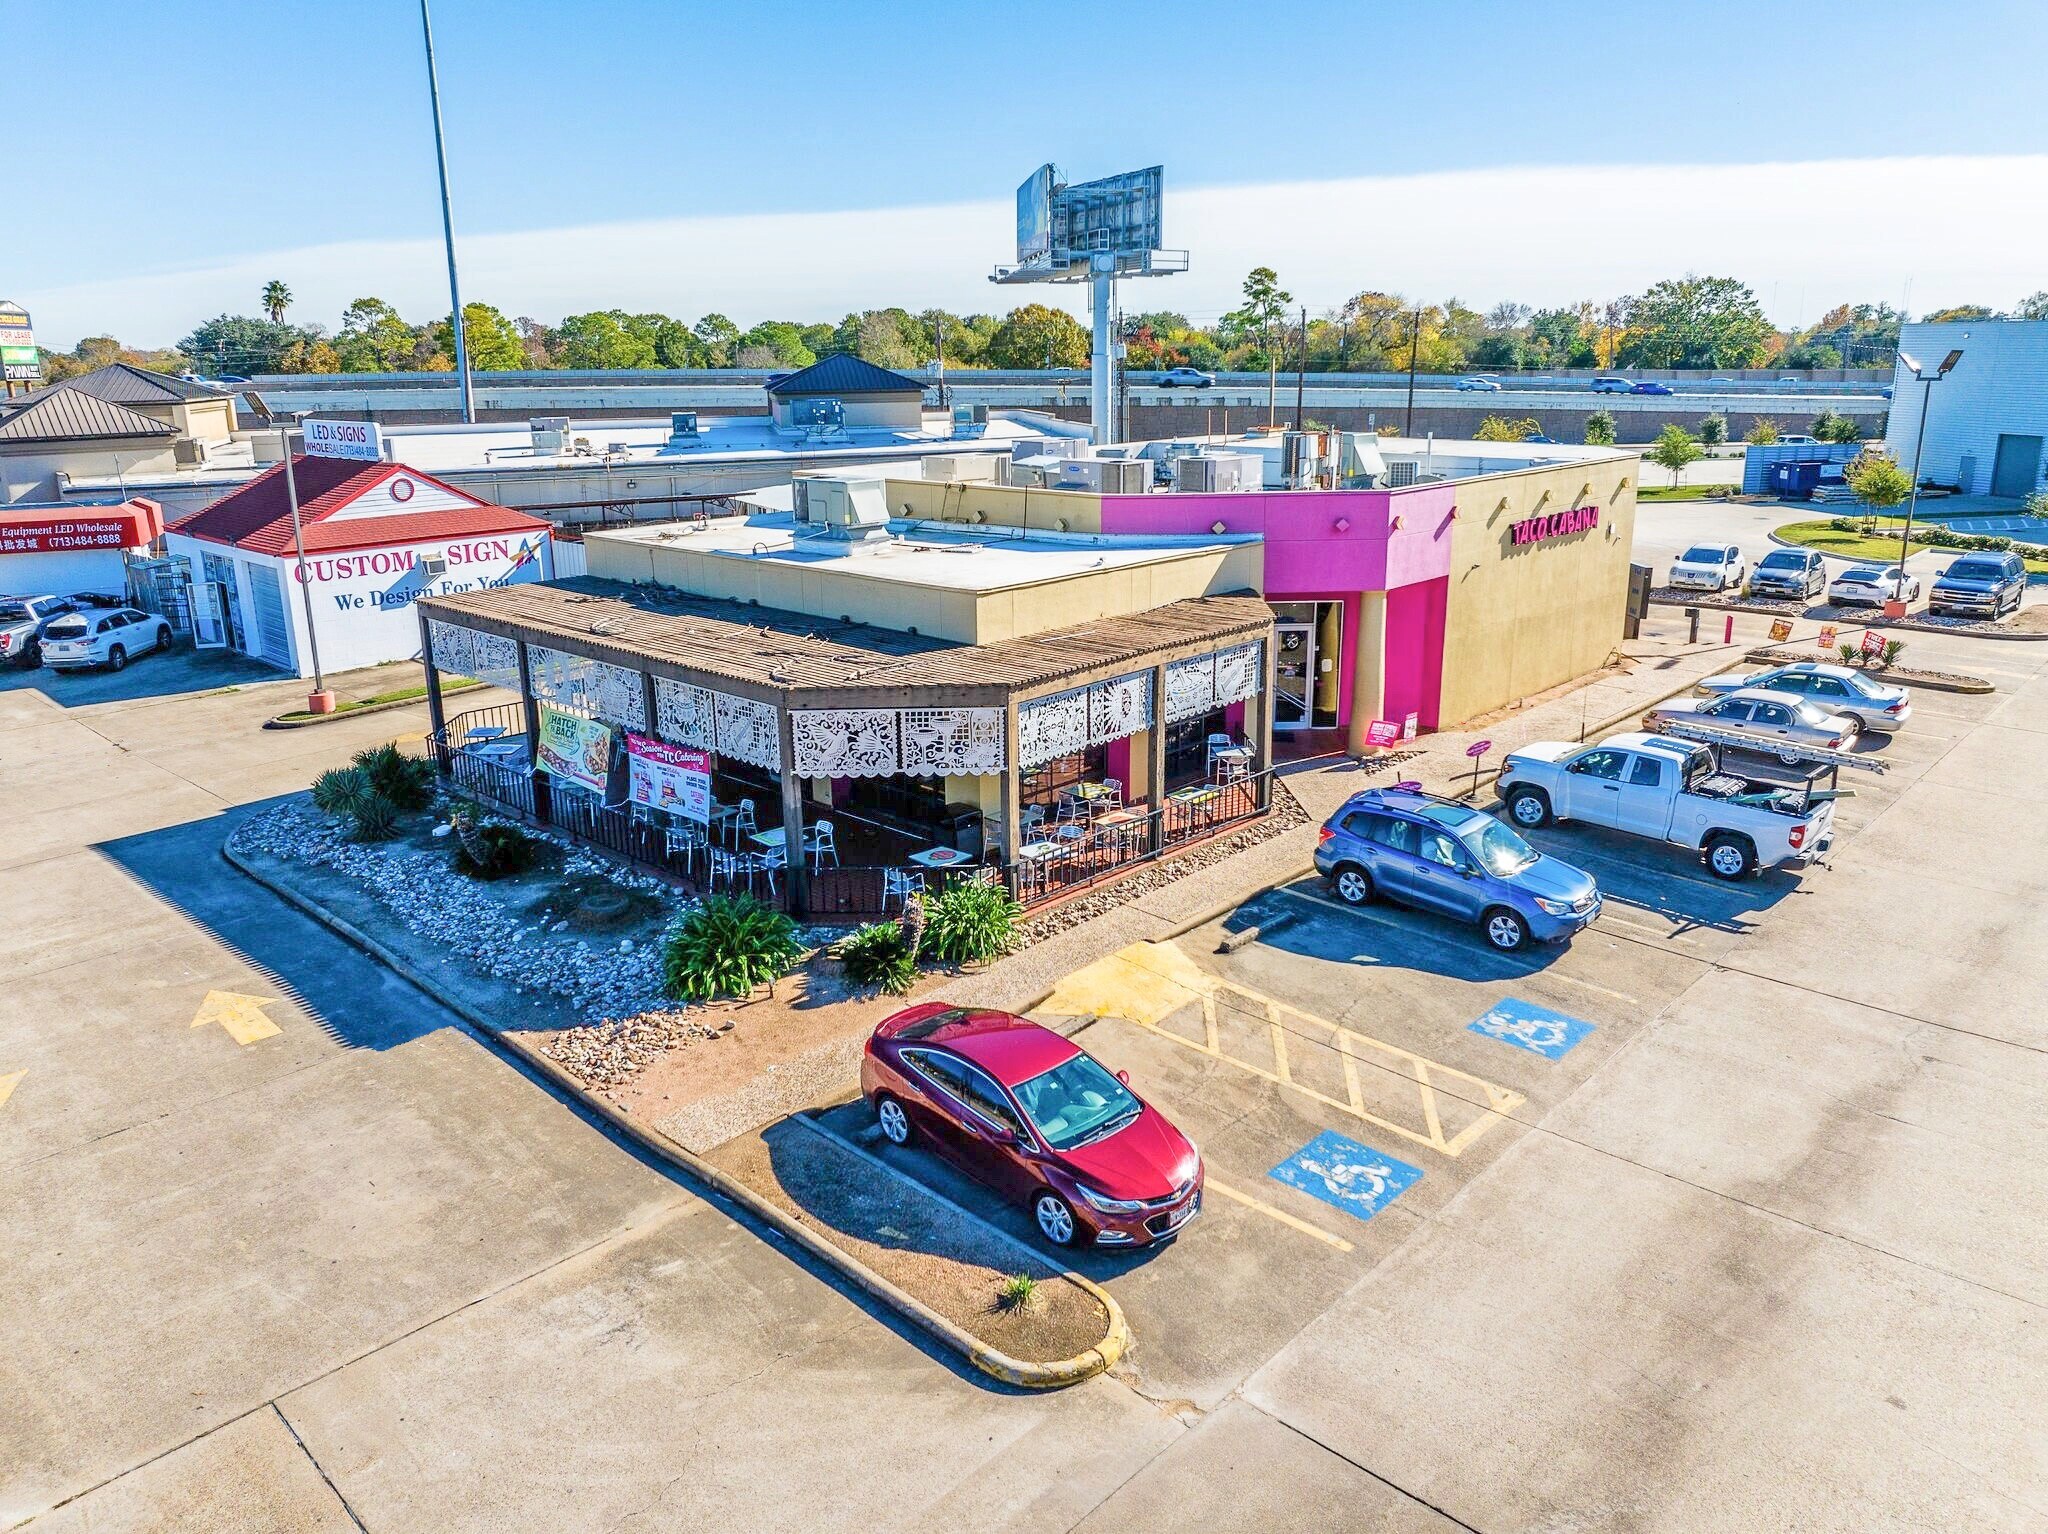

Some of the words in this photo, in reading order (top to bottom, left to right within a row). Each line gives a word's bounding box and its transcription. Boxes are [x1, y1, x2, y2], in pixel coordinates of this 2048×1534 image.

[13, 331, 31, 339] LEASE
[6, 365, 30, 378] PAWN
[312, 424, 329, 440] LED
[330, 426, 337, 440] &
[337, 425, 367, 443] SIGNS
[305, 442, 344, 455] WHOLESALE
[2, 526, 52, 538] Equipment
[55, 524, 74, 534] LED
[76, 523, 122, 533] Wholesale
[1513, 516, 1548, 546] TACO
[1549, 506, 1598, 537] CABANA
[49, 534, 120, 547] (713)484-8888
[294, 550, 415, 584] CUSTOM
[447, 539, 509, 566] SIGN
[334, 593, 364, 611] We
[369, 585, 434, 607] Design
[441, 580, 473, 597] For
[551, 715, 577, 730] HATCH
[555, 727, 576, 739] BACK
[663, 751, 675, 763] TC
[674, 751, 704, 766] Catering
